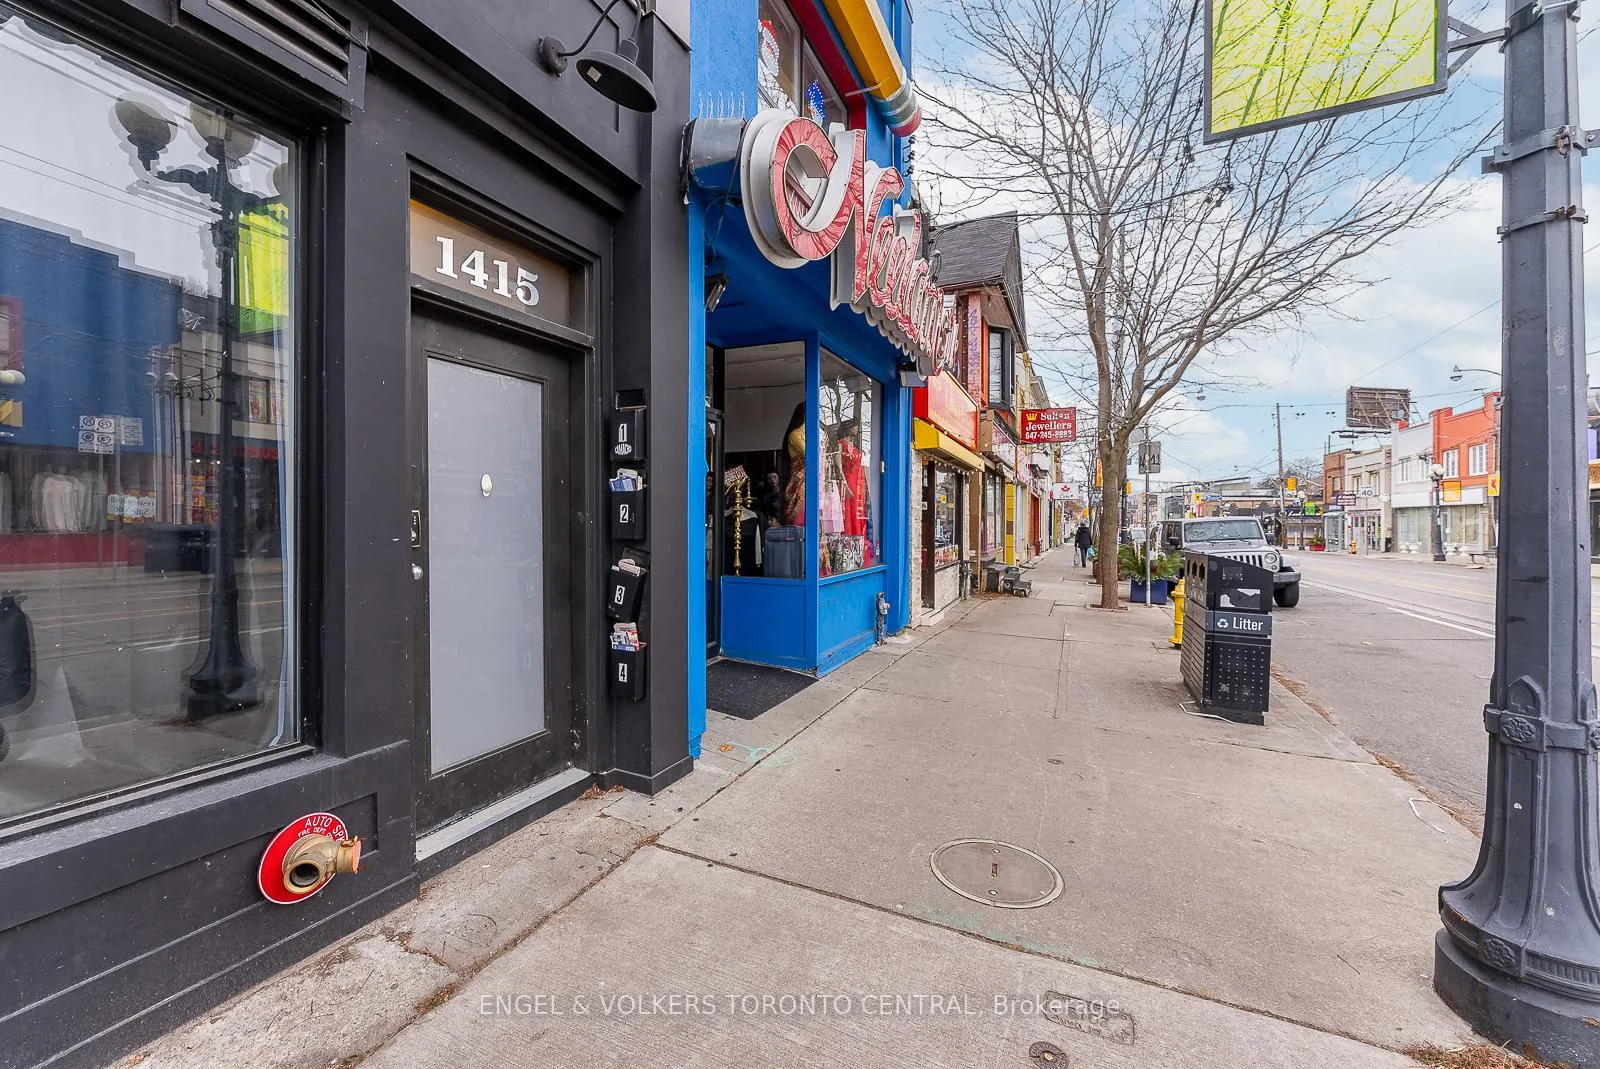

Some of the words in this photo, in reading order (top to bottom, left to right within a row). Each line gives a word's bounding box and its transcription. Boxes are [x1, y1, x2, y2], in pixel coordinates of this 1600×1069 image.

[435, 235, 540, 307] 1415
[1040, 411, 1070, 421] Sultan
[618, 423, 628, 443] 1
[1025, 421, 1072, 431] Jewellers
[1361, 489, 1373, 497] 40
[621, 505, 628, 522] 2
[616, 586, 624, 603] 3
[1233, 616, 1263, 631] Litter
[619, 664, 627, 681] 4
[305, 816, 332, 828] AUTO
